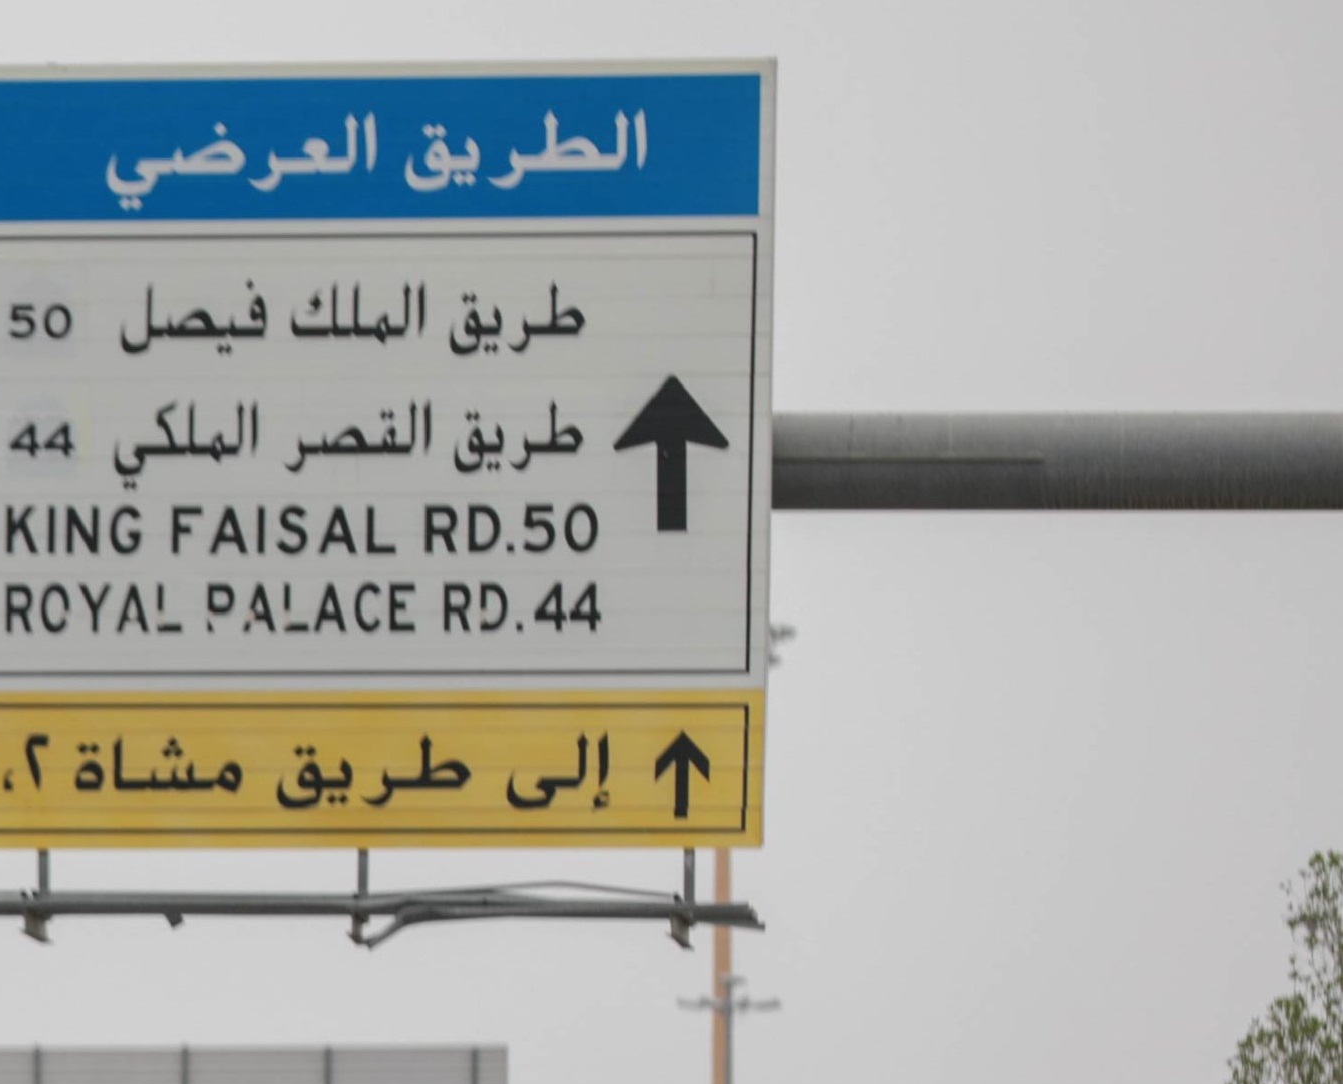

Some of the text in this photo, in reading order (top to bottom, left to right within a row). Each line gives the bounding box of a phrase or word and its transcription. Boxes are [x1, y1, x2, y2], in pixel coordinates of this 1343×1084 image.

[106, 109, 648, 210] الطريق العرضي
[9, 280, 586, 356] طريق الملك فيصل 50
[9, 401, 584, 490] طريق القصر الملكي 44
[5, 505, 142, 555] KING
[171, 505, 397, 555] FAISAL
[5, 582, 183, 634] ROYAL
[206, 582, 416, 633] PALACE
[74, 738, 243, 793] مشاة
[276, 735, 472, 810] طريق
[506, 733, 610, 811] إلى
